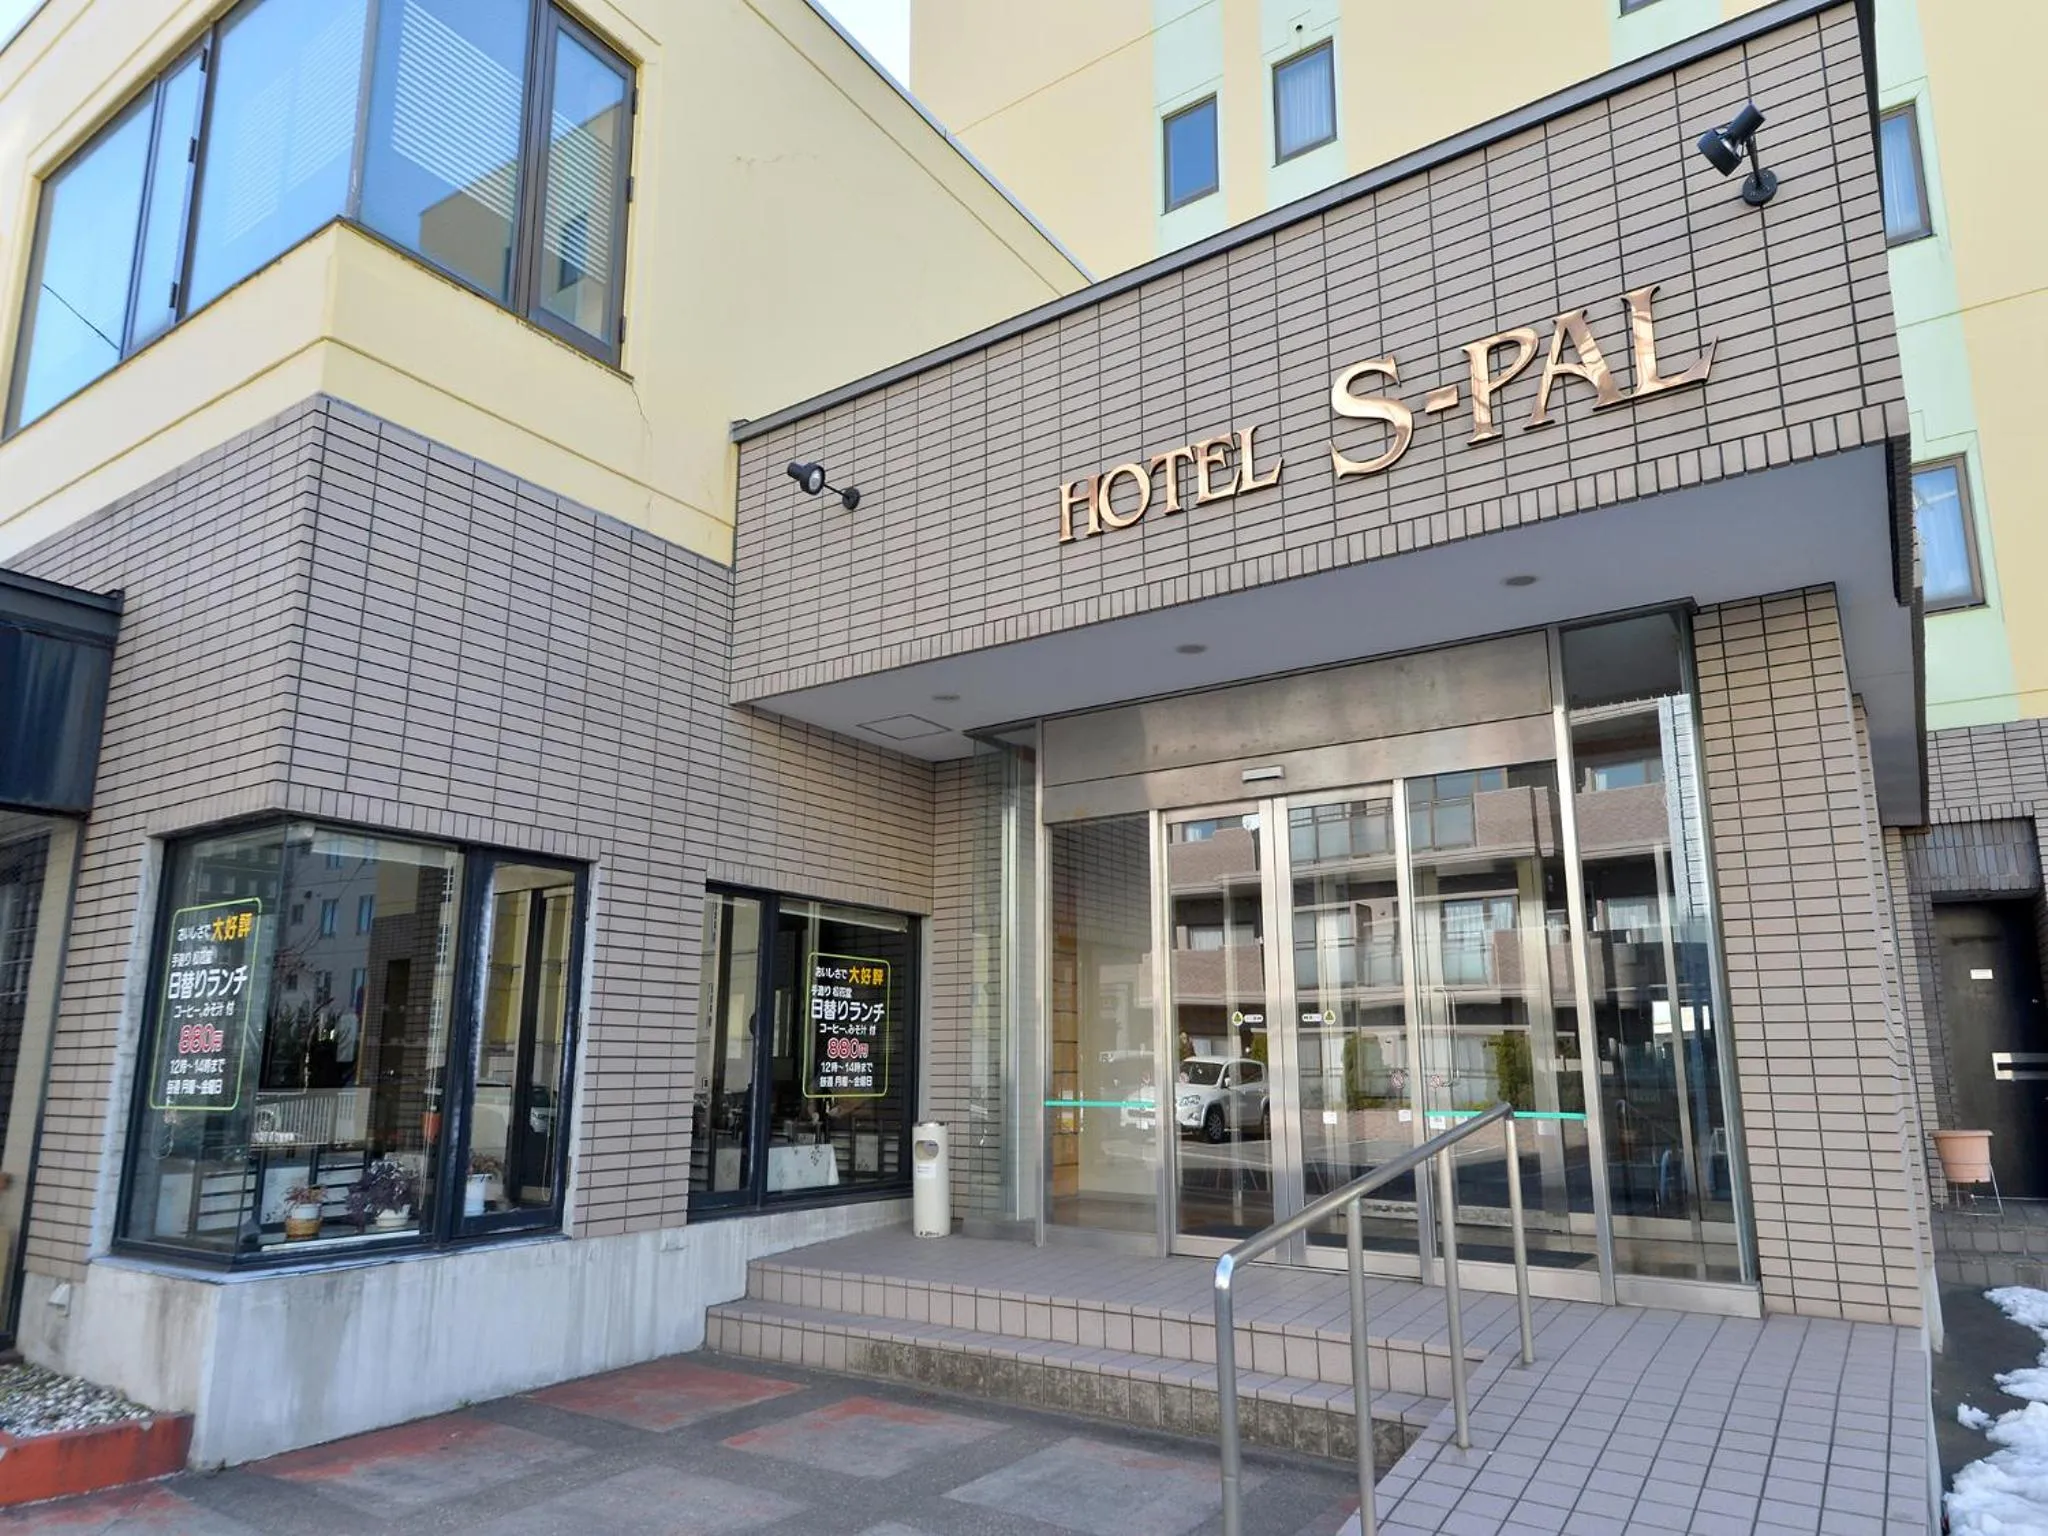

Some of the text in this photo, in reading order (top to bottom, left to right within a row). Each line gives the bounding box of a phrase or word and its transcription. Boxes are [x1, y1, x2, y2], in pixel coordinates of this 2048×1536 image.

[1058, 284, 1718, 543] HOTEL S-PAL
[168, 964, 249, 1000] 日替りランチ
[811, 998, 885, 1023] 日替りランチ
